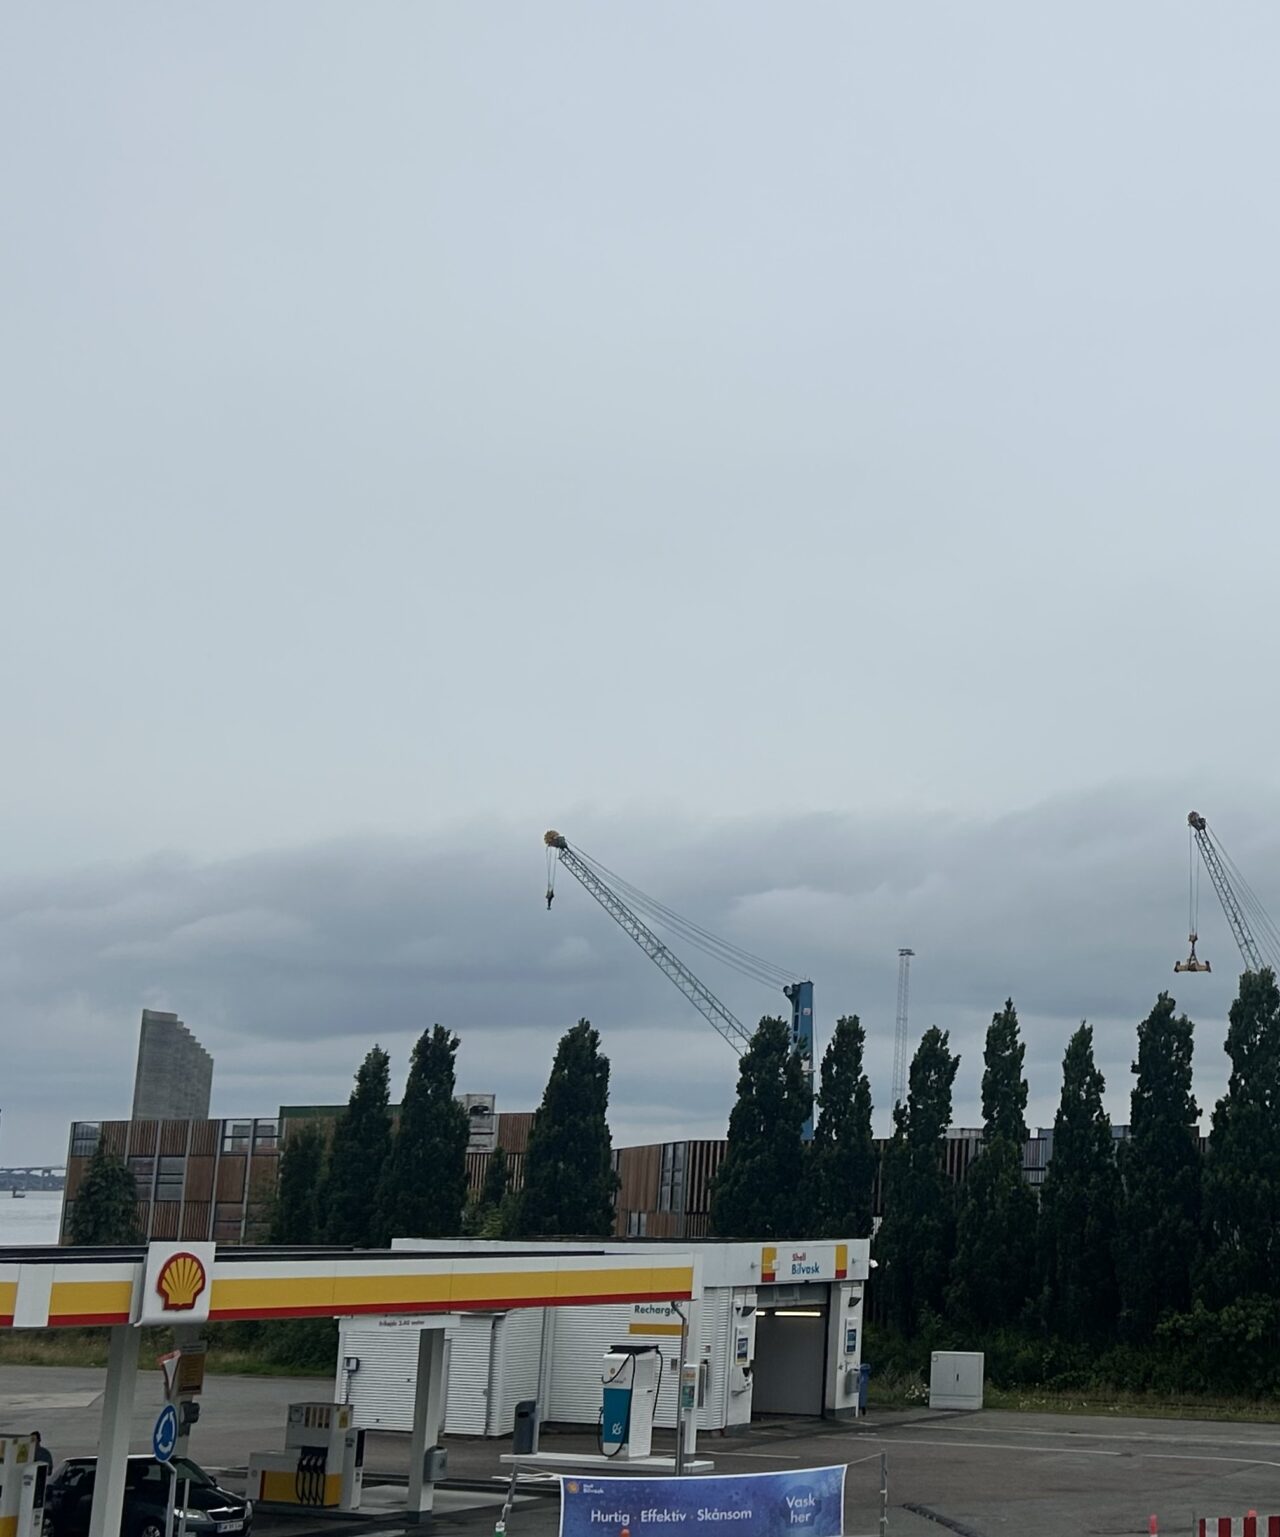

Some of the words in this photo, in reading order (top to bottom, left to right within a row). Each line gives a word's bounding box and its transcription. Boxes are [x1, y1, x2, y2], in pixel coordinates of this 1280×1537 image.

[791, 1262, 820, 1275] Bilvask
[634, 1304, 677, 1317] Recharge
[785, 1493, 816, 1508] Vask
[591, 1509, 630, 1526] Hurtig
[640, 1508, 687, 1522] Effektiv
[697, 1507, 752, 1521] Skånsom
[790, 1511, 812, 1524] her
